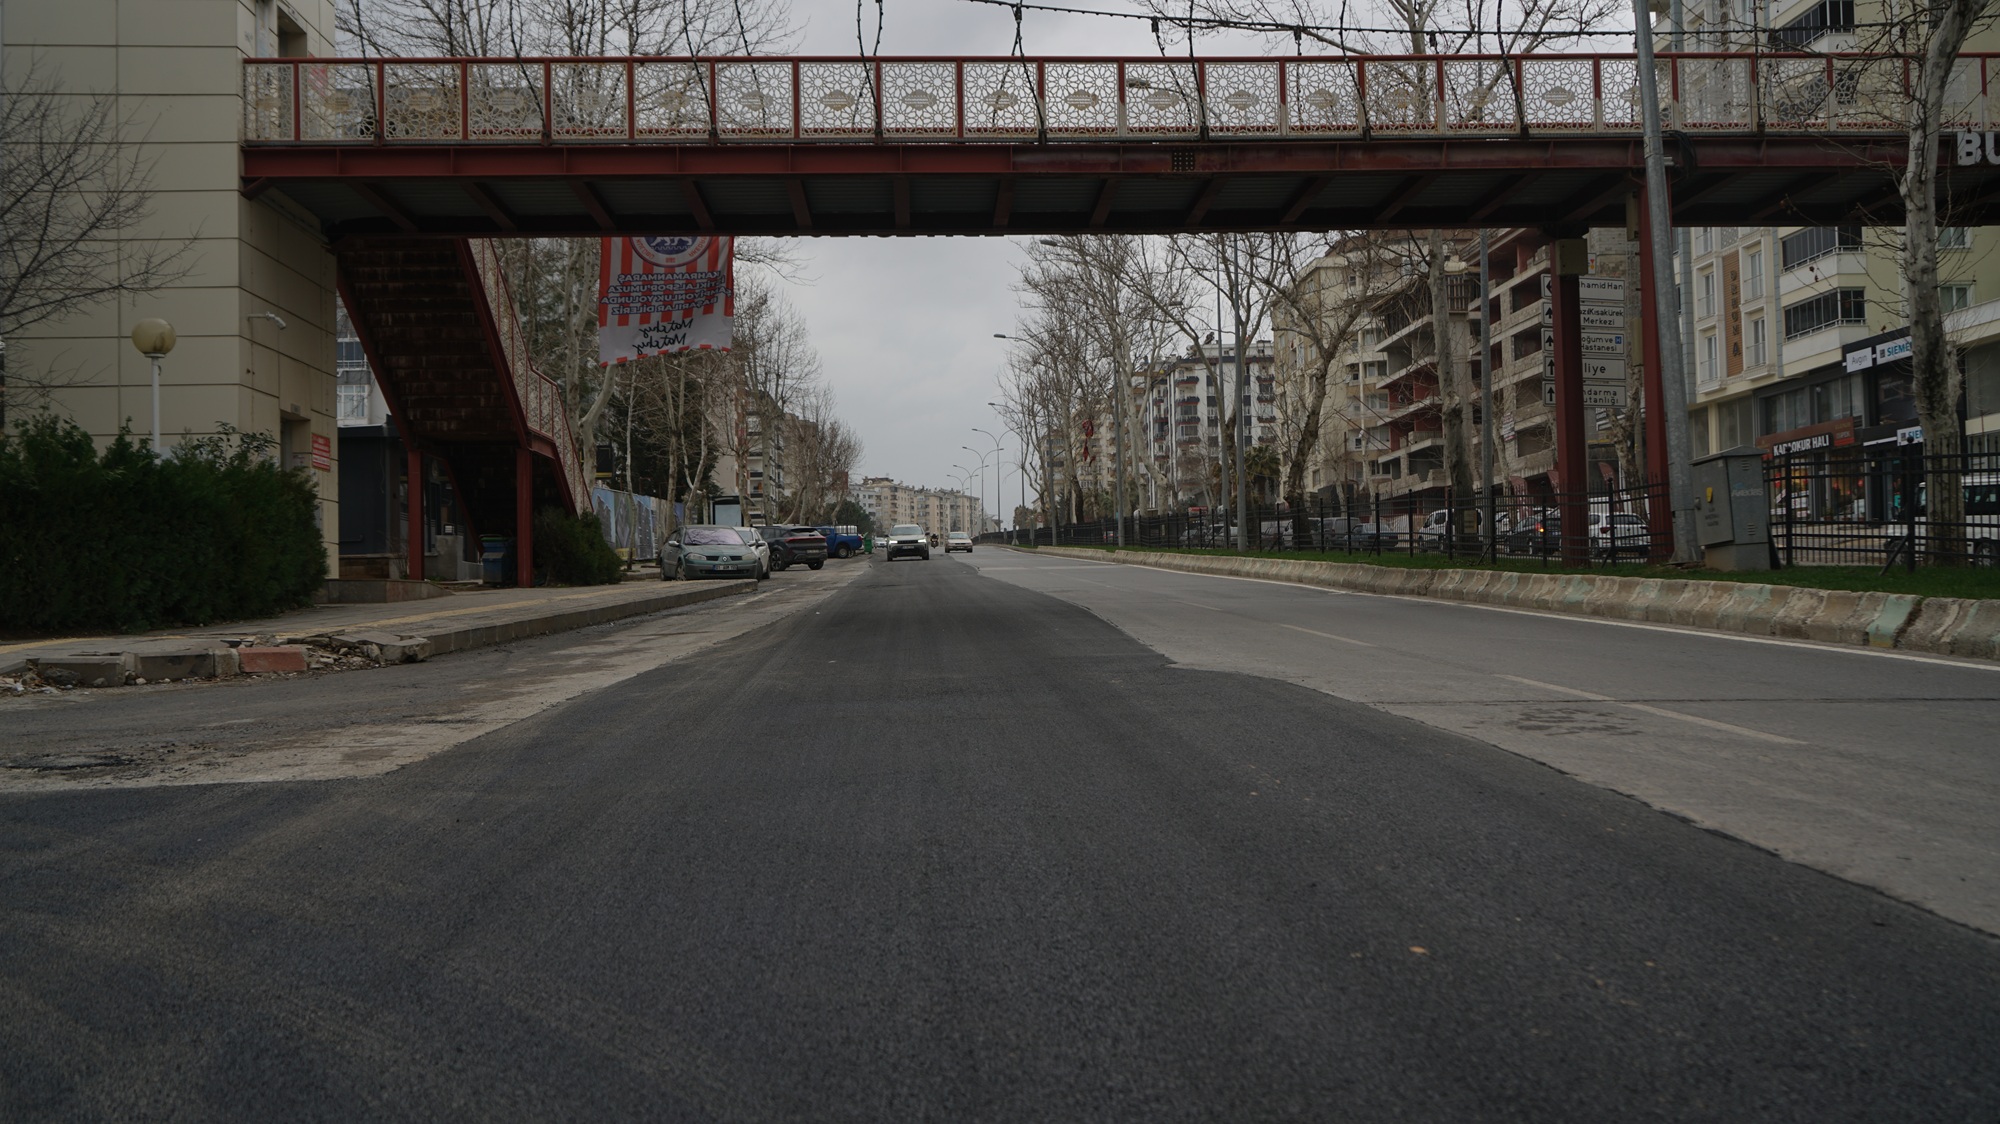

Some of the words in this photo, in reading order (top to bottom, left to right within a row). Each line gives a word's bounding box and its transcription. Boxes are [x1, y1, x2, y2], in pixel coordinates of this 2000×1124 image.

[1580, 281, 1606, 289] hamid
[1607, 282, 1623, 290] Han
[1583, 317, 1615, 325] Merkezi
[1581, 335, 1603, 344] oğum
[1584, 363, 1606, 376] liye
[1583, 388, 1617, 396] ndarma
[1583, 396, 1619, 405] utanlığı
[1812, 434, 1830, 449] HALI
